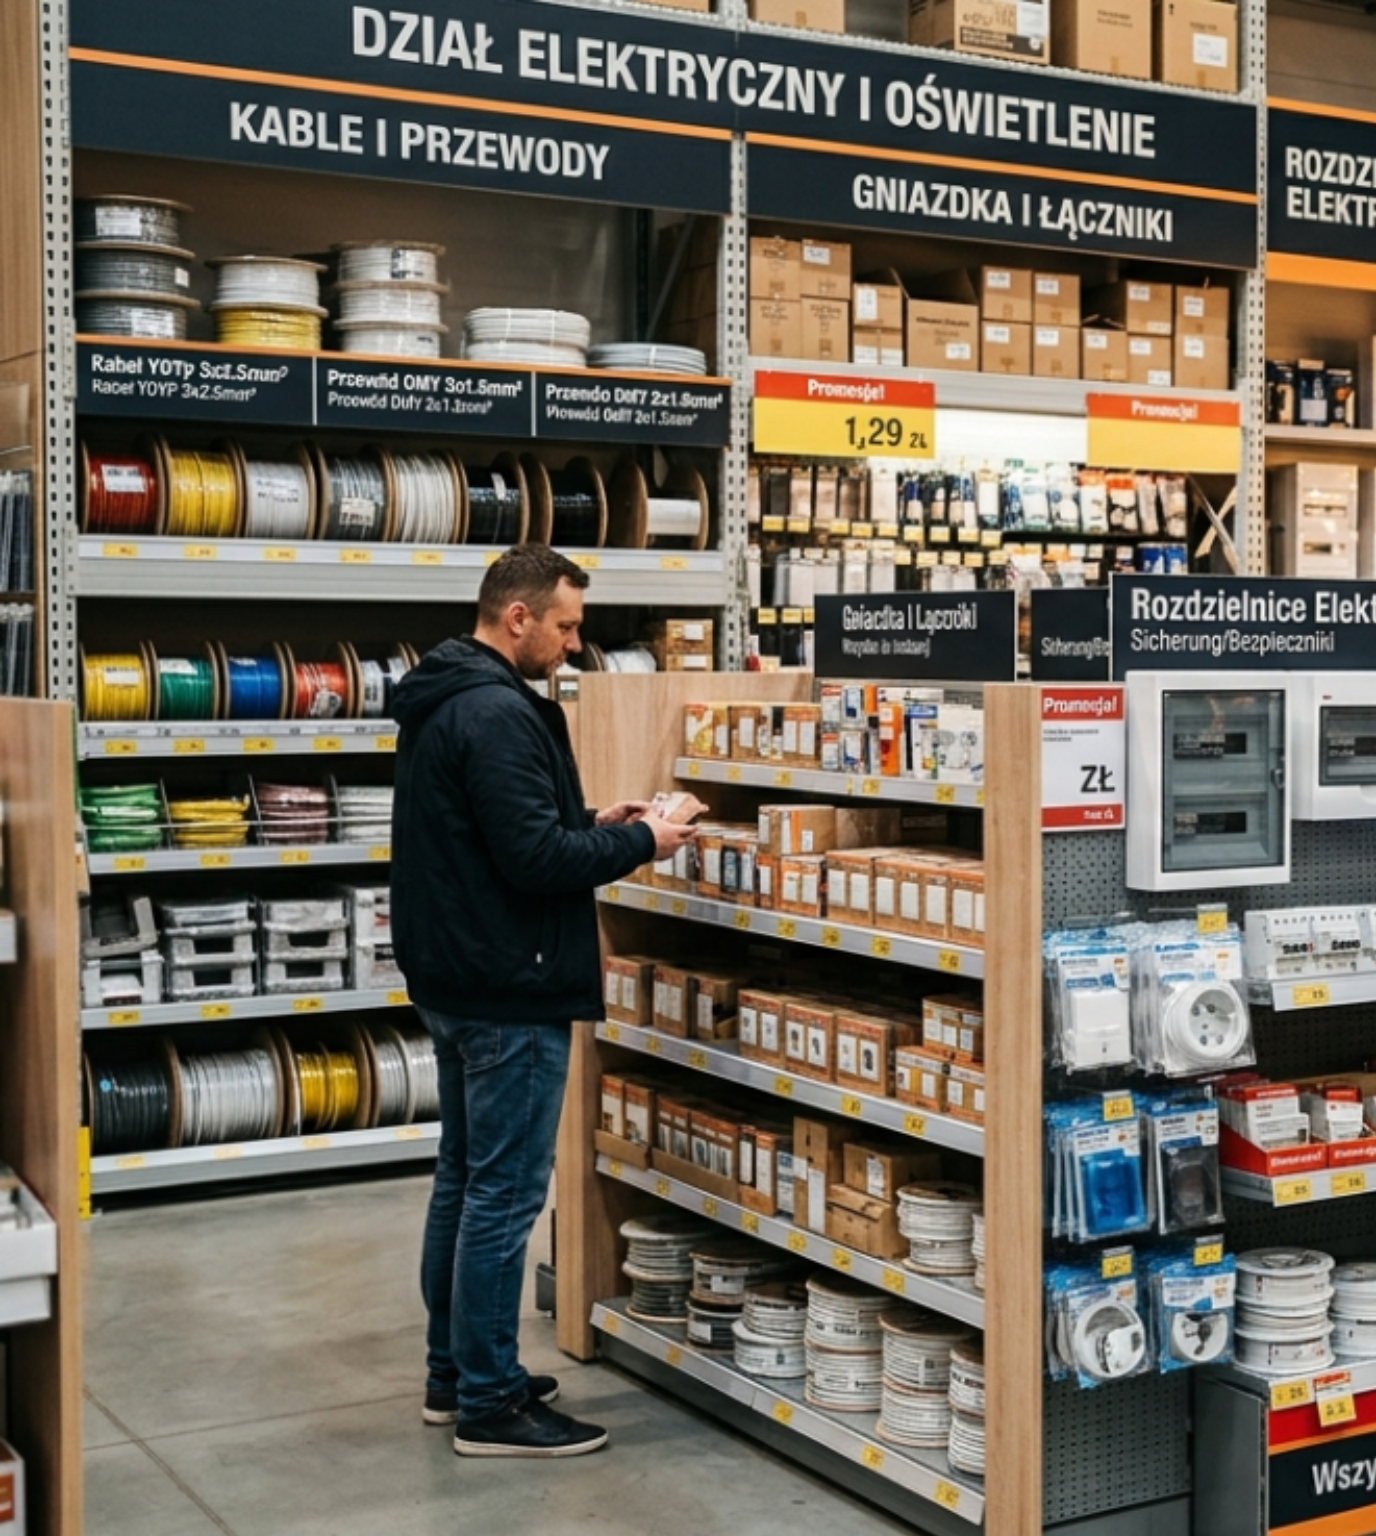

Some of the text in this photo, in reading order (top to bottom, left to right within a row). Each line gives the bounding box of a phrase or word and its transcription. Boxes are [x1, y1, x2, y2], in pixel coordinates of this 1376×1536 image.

[352, 5, 1156, 159] DZIAŁ ELEKTRYCZNY I OŚWIETLENIE
[230, 101, 610, 180] KABLE I PRZEWODY
[852, 173, 1174, 242] GNIAZDKA I ŁĄCZNIKI
[845, 416, 903, 450] 1,29
[1132, 588, 1307, 622] Rozdzielnice
[1080, 764, 1115, 793] ZŁ
